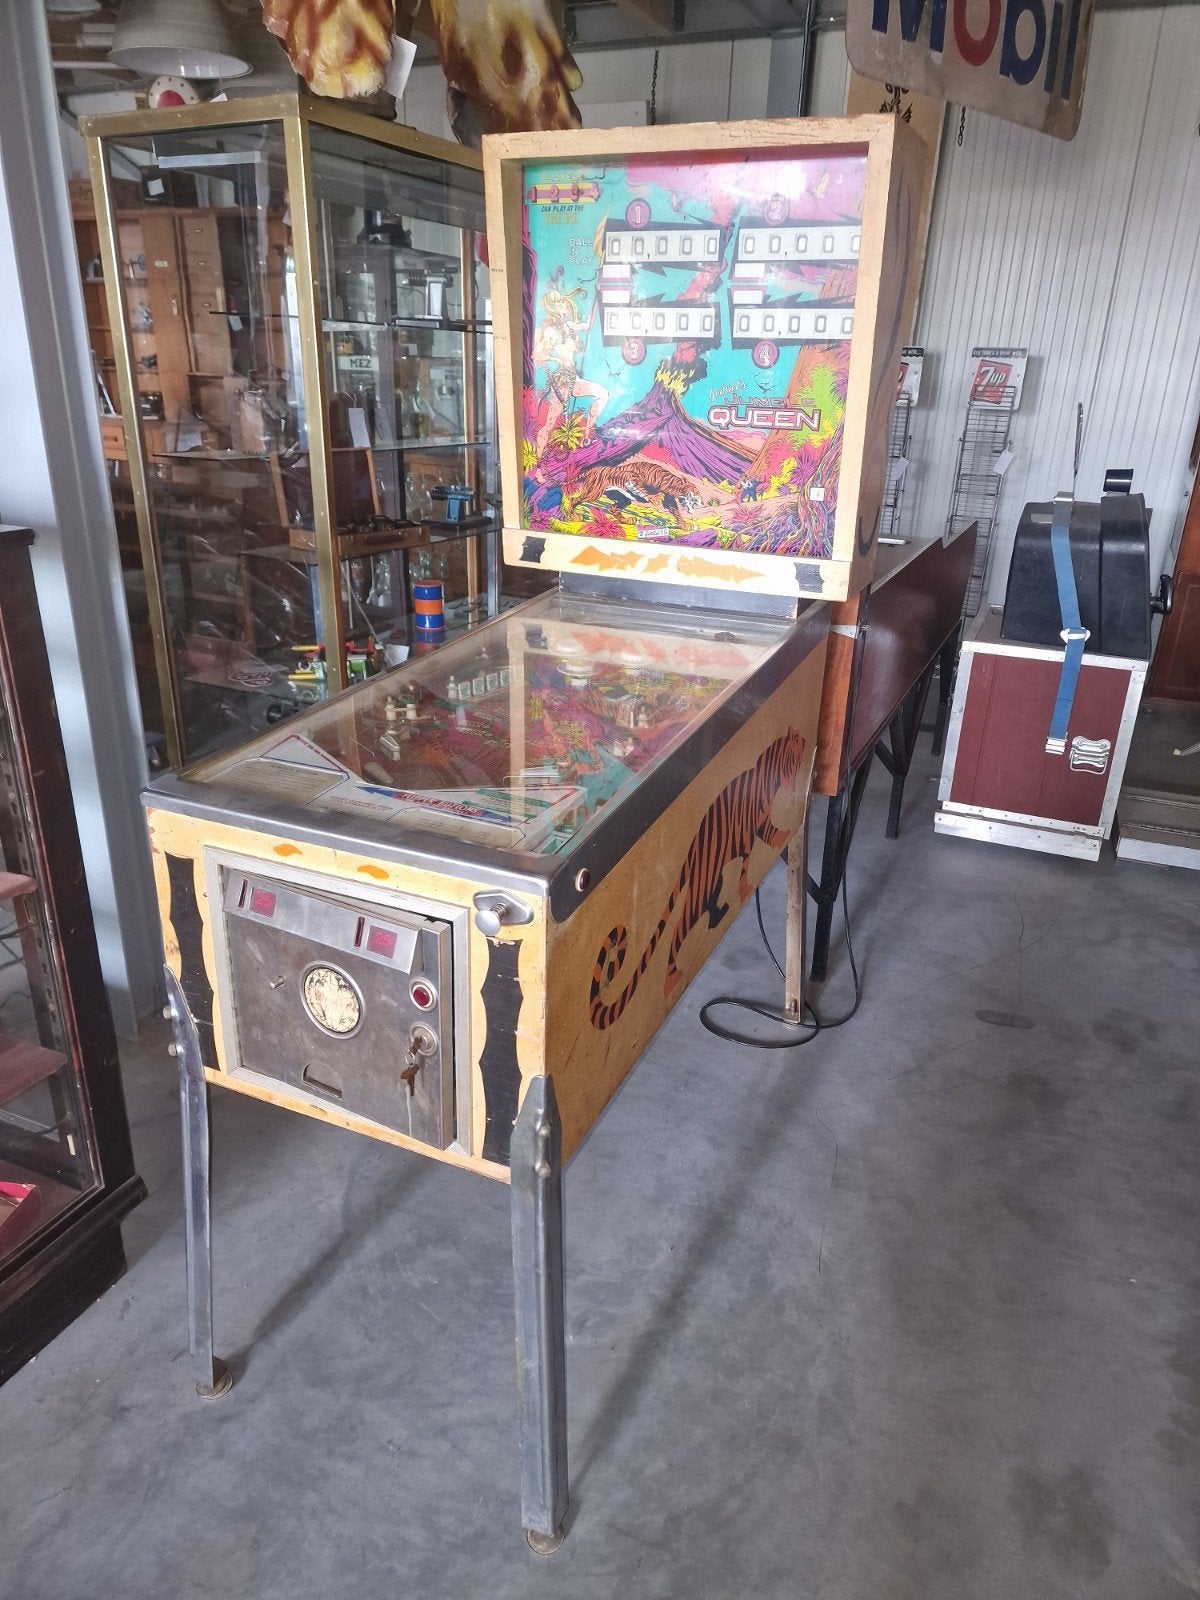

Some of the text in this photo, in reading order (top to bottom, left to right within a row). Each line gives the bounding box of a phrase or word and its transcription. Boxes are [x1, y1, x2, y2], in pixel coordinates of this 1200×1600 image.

[768, 200, 784, 220] 2
[569, 238, 593, 247] BALL
[569, 247, 579, 256] IN
[569, 257, 594, 266] PLAY
[627, 340, 640, 360] 3
[758, 343, 771, 368] 4
[977, 365, 1007, 392] 7up
[723, 393, 818, 408] JUNGLE
[707, 404, 822, 432] QUEEN
[374, 930, 394, 948] 25
